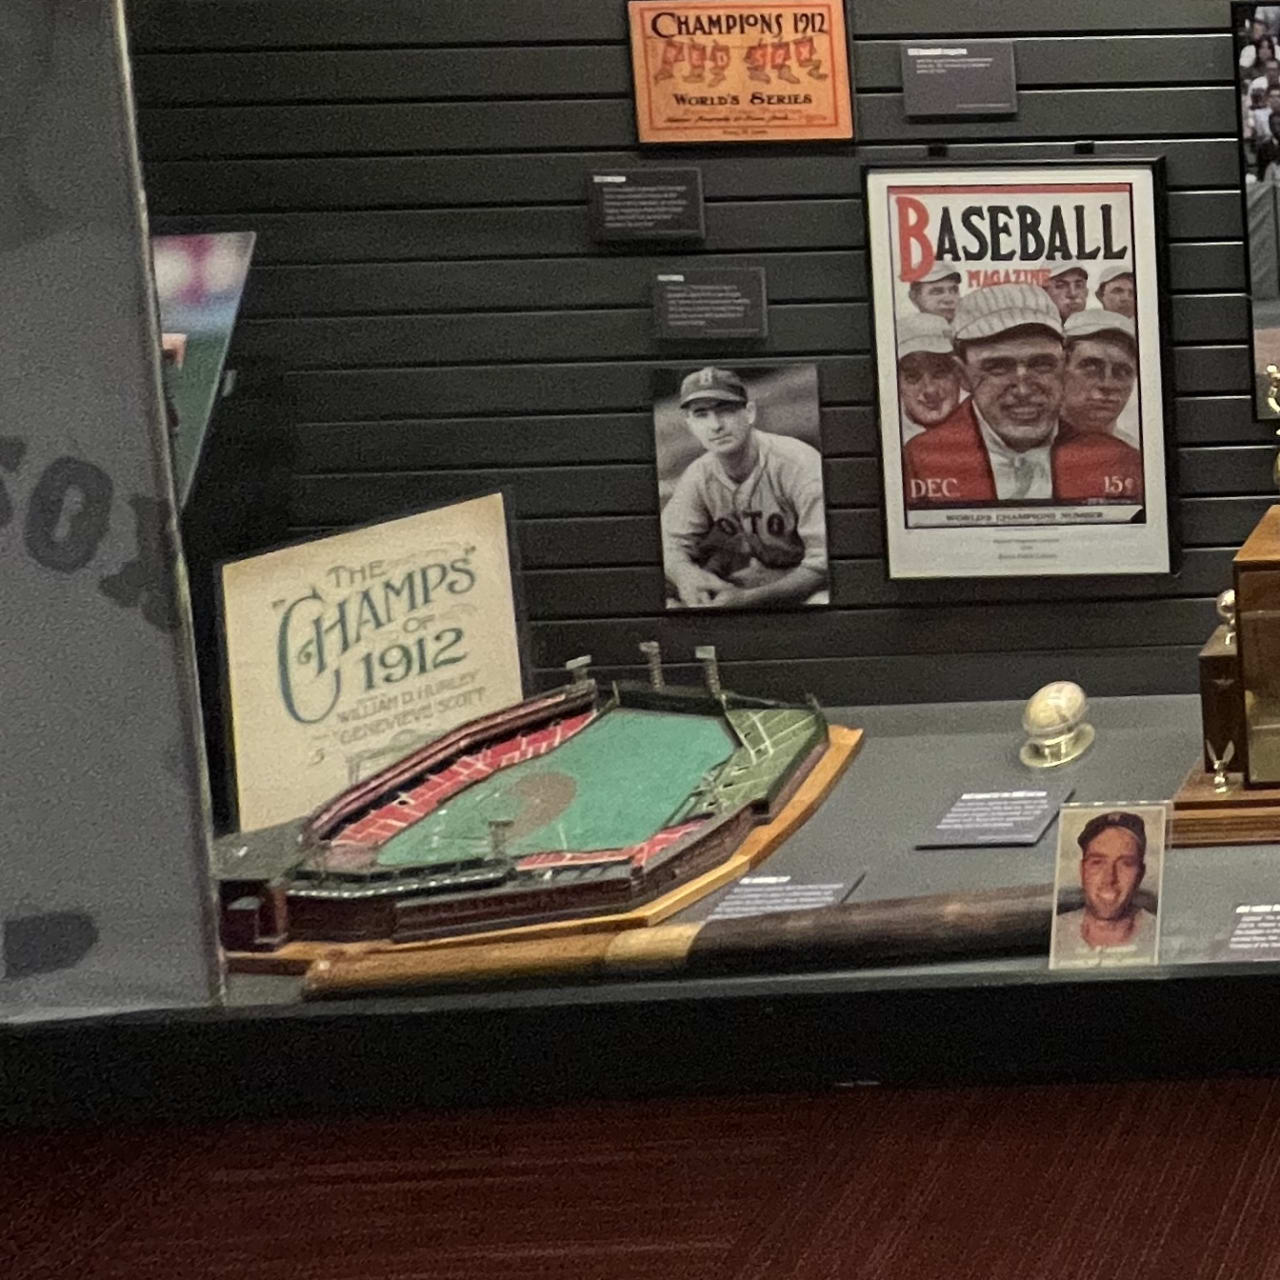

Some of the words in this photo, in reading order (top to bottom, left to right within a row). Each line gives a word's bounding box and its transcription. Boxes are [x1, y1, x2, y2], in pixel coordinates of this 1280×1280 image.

[651, 12, 783, 39] CHAMPIONS
[793, 12, 828, 34] 1912
[673, 93, 741, 106] WORLD'S
[749, 92, 813, 106] SERIES
[895, 196, 1128, 283] BASEBALL
[0, 436, 180, 634] OX
[327, 559, 388, 588] THE
[402, 614, 436, 634] OF
[361, 627, 470, 690] 1912
[337, 695, 399, 721] WILLIAM
[438, 687, 487, 712] SCOTT
